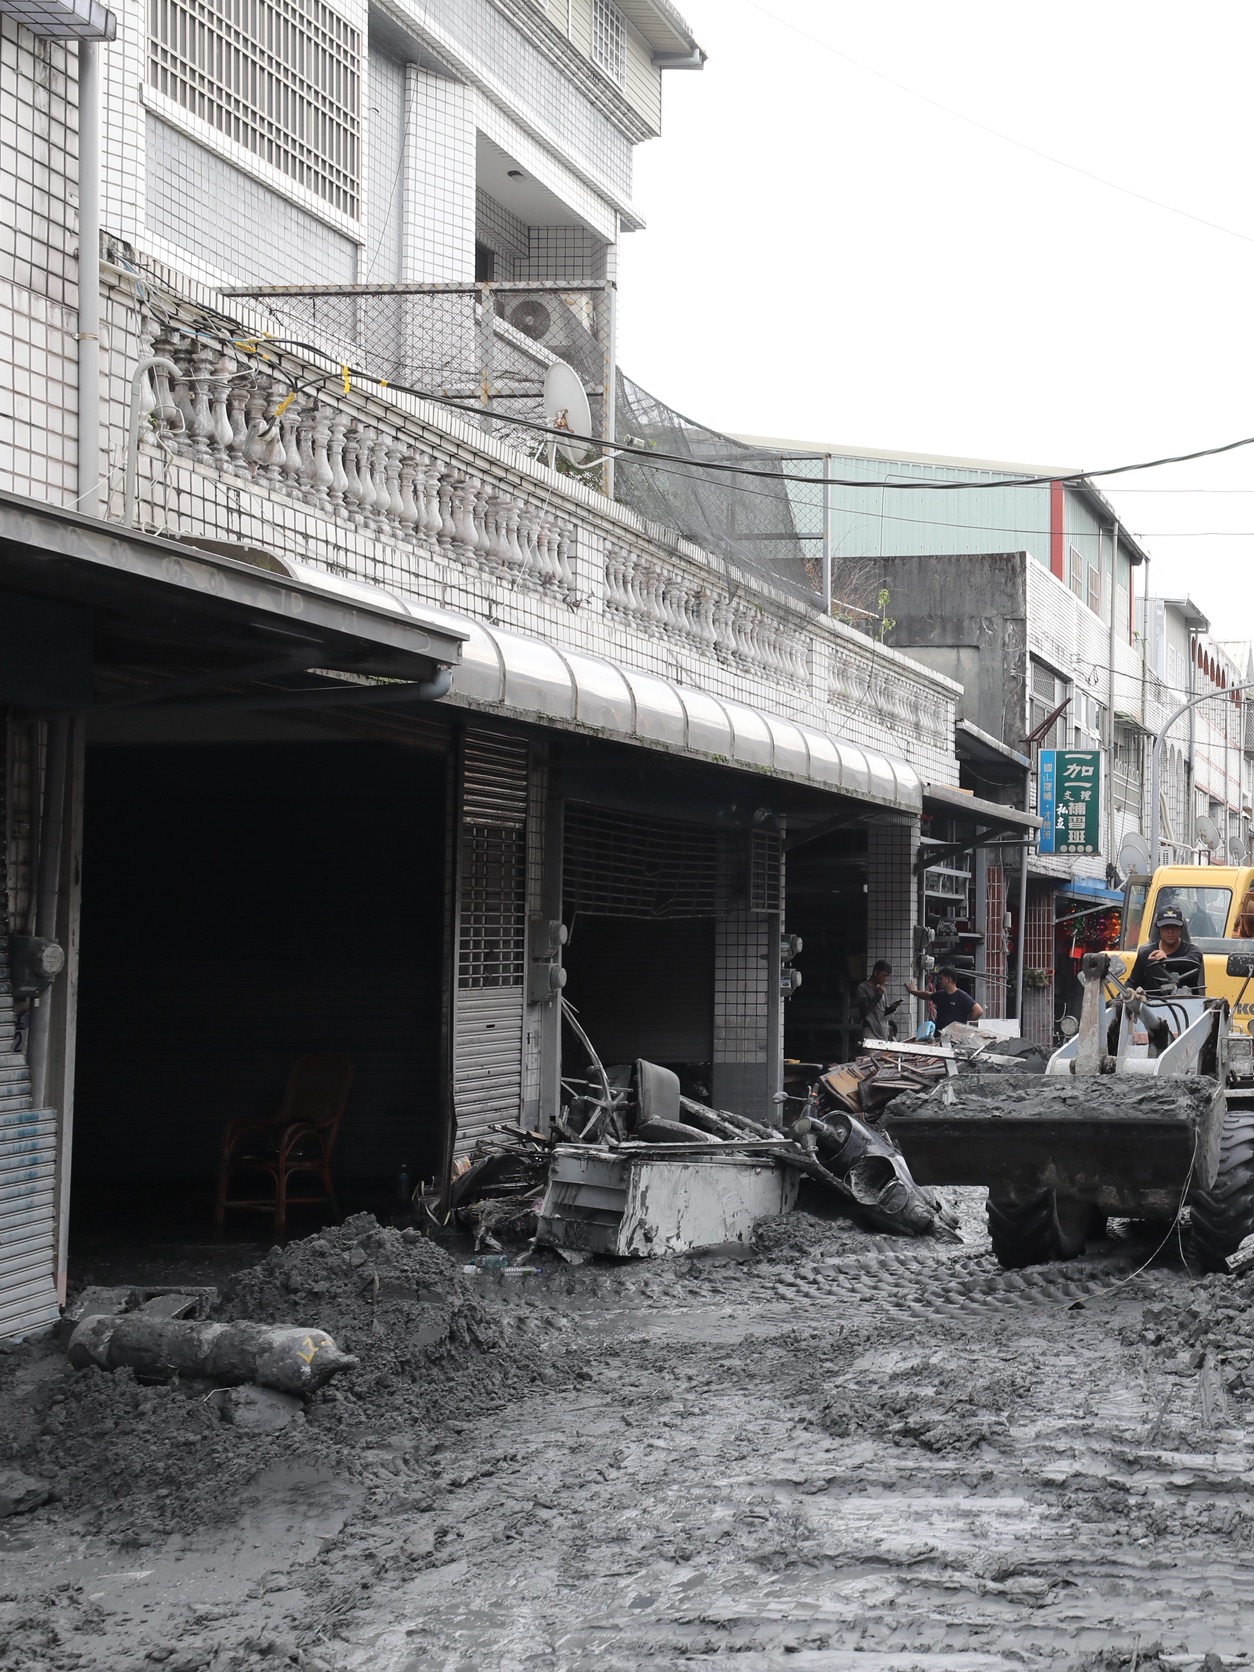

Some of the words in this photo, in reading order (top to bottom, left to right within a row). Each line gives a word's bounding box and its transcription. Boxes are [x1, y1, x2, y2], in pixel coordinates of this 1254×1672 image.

[1056, 803, 1068, 829] 私立
[1067, 802, 1087, 843] 補習班
